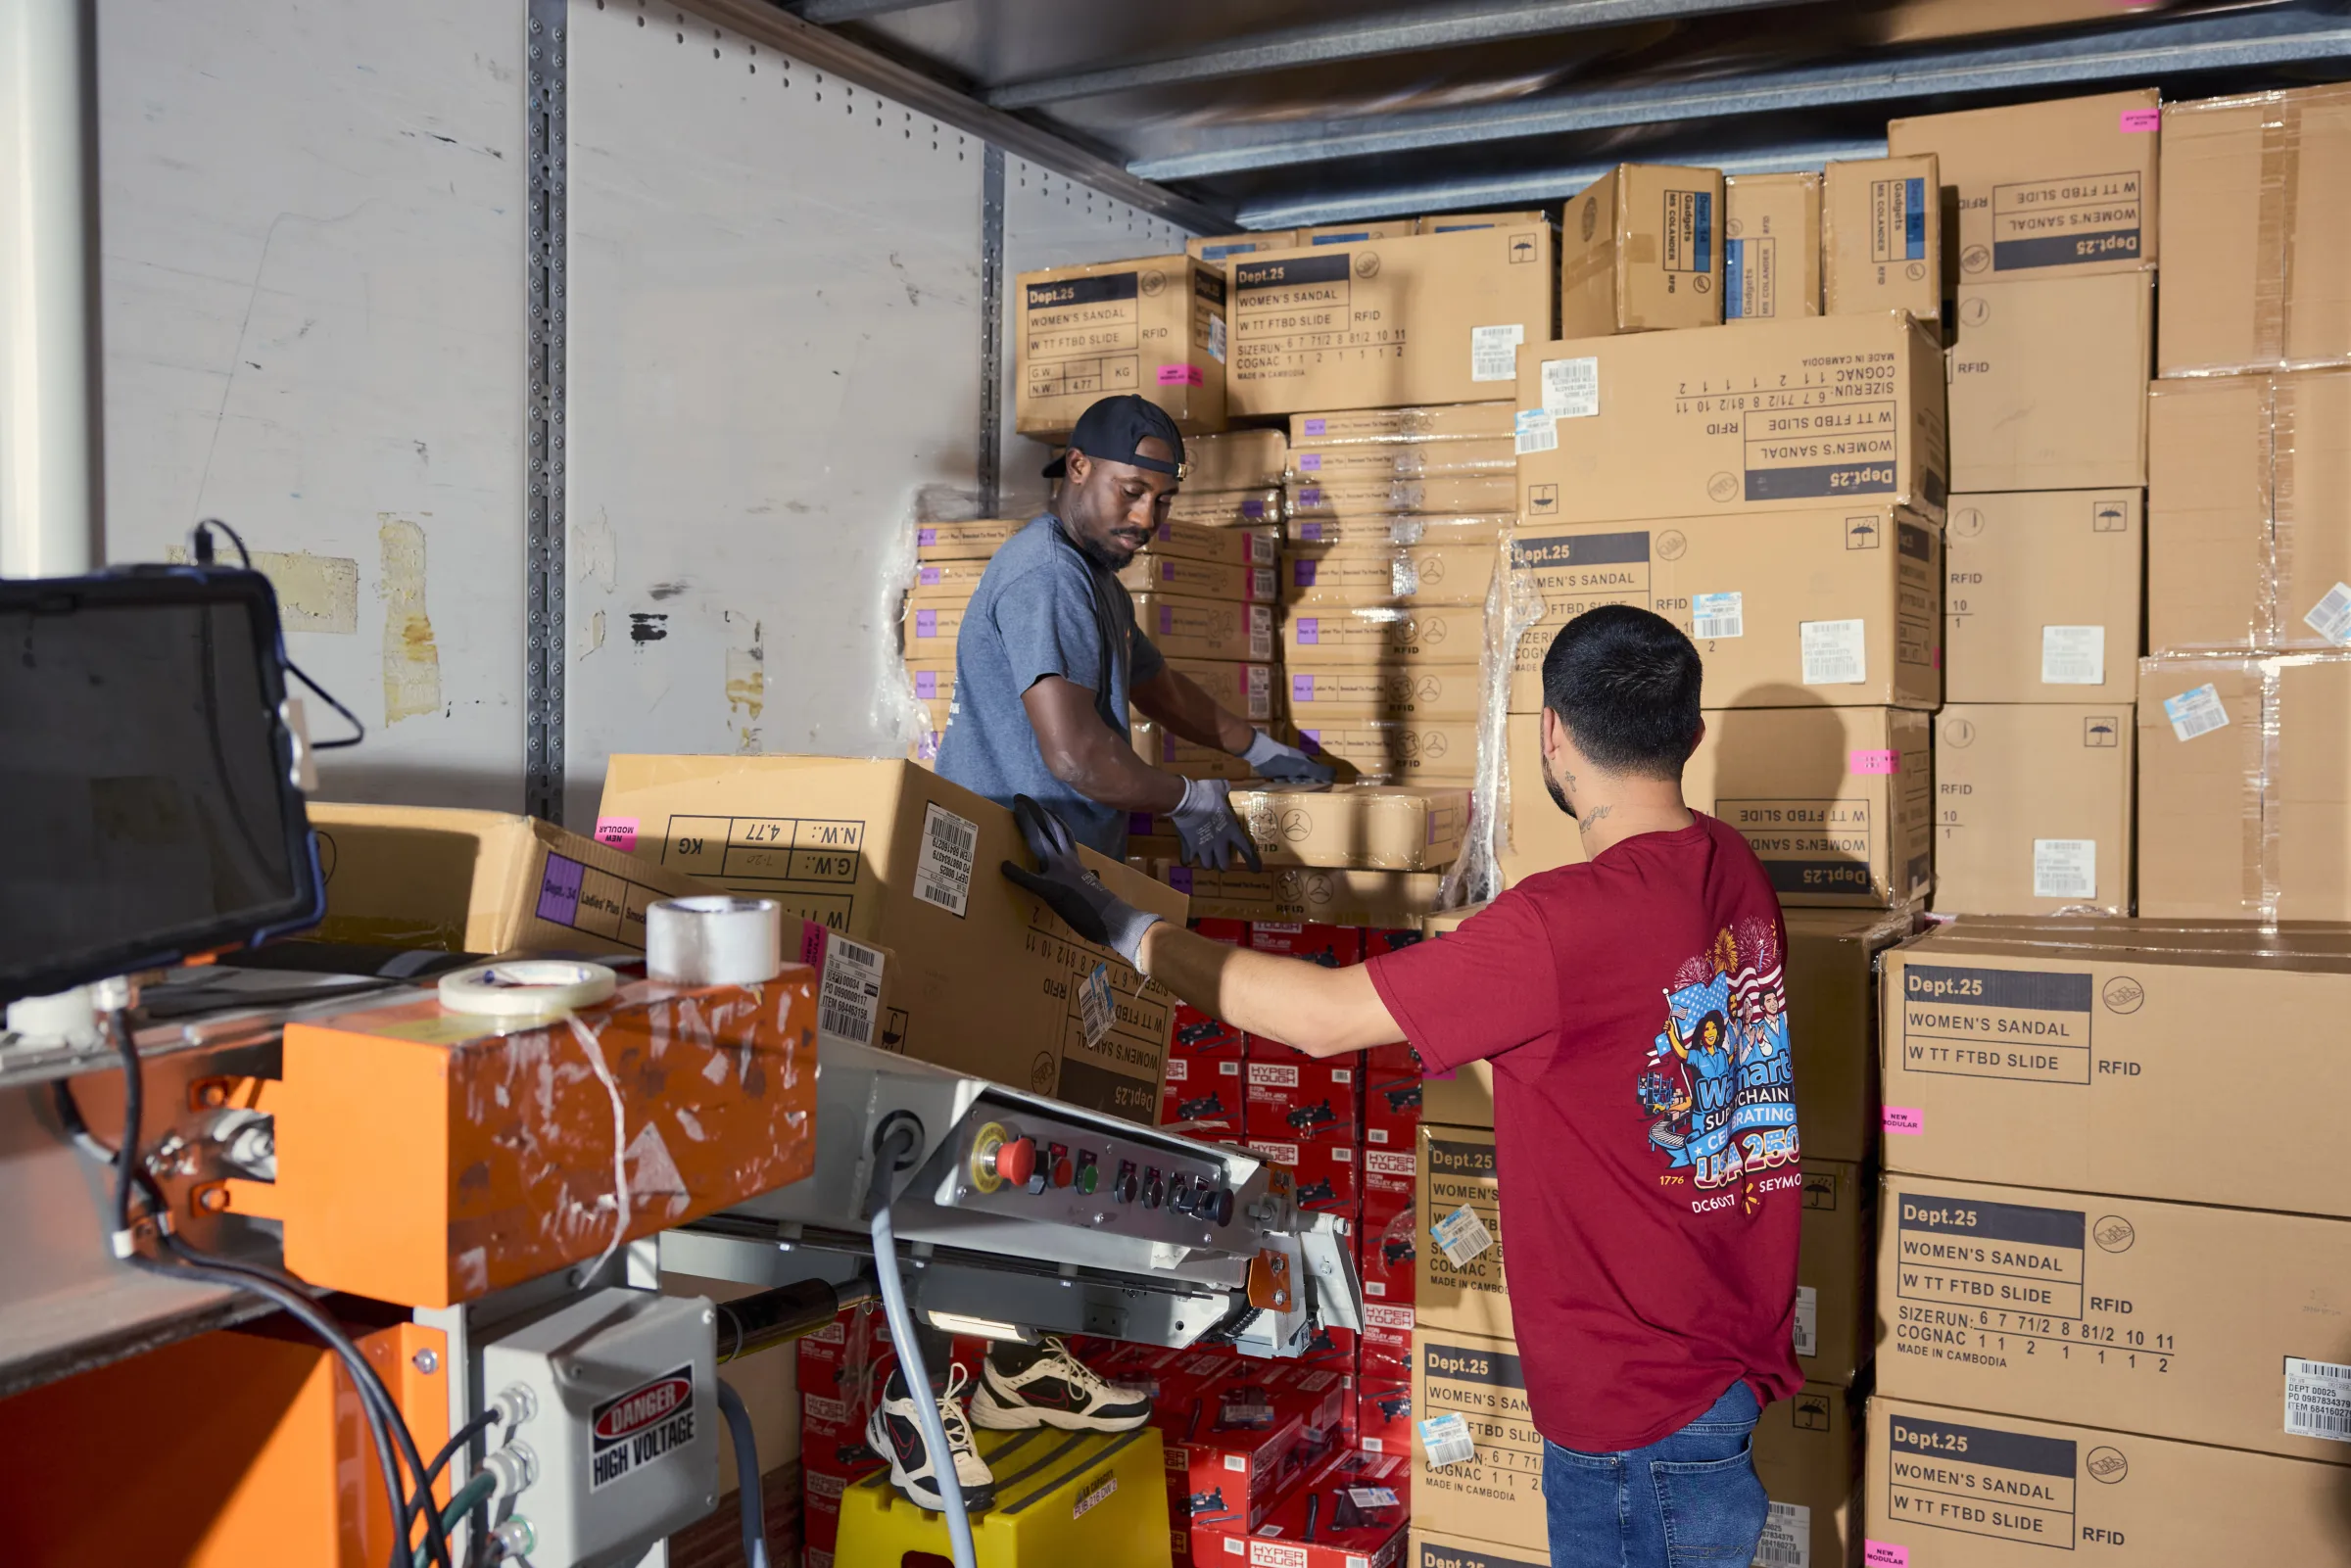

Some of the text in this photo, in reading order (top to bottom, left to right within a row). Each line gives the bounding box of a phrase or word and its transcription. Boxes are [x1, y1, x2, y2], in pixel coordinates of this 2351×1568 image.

[2017, 181, 2136, 204] W TT FTBD SLIDE
[1894, 183, 1904, 230] Gadgets
[1683, 195, 1694, 242] Gadgets
[2009, 208, 2136, 232] WOMEN'S SANDAL
[1668, 212, 1677, 261] COLANDER
[2076, 236, 2137, 256] Dept.25
[1238, 267, 1285, 284] Dept.25
[1030, 287, 1075, 305] Dept.25
[1239, 290, 1338, 308] WOMEN'S SANDAL
[1744, 268, 1754, 315] Gadgets
[1032, 309, 1126, 327] WOMEN'S SANDAL
[1269, 313, 1332, 329] FTBD SLIDE
[1354, 309, 1381, 322] RFID
[1089, 332, 1120, 346] SLIDE
[1143, 327, 1168, 340] RFID
[1237, 356, 1280, 370] COGNAC
[1801, 353, 1895, 367] MADE IN CAMBODIA
[1957, 361, 1990, 374] RFID
[1115, 367, 1130, 378] KG
[1836, 364, 1895, 382] COGNAC
[1706, 421, 1739, 436] RFID
[1768, 410, 1893, 432] W TT FTBD SLIDE
[1760, 439, 1893, 460] WOMEN'S SANDAL
[1830, 468, 1894, 488] Dept.25
[1581, 572, 1635, 586] SANDAL
[1950, 573, 1983, 585] RFID
[1551, 602, 1585, 615] FTBD
[1655, 597, 1688, 610] RFID
[1952, 599, 1967, 612] 10
[1389, 704, 1415, 713] RFID
[1941, 784, 1973, 795] RFID
[1740, 809, 1865, 823] W TT FTBD SLIDE
[1943, 810, 1958, 822] 10
[599, 826, 634, 834] MODULAR
[604, 834, 623, 843] NEW
[745, 824, 781, 841] 4.77
[678, 837, 703, 855] KG
[1796, 838, 1866, 852] WOMEN'S
[960, 849, 973, 863] ITEM
[1802, 868, 1867, 885] Dept.25
[1275, 904, 1305, 914] RFID
[1043, 977, 1068, 1000] RFID
[1908, 974, 1984, 997] Dept.25
[1115, 1004, 1153, 1029] TT FTBD
[1909, 1013, 2070, 1037] WOMEN'S SANDAL
[1116, 1043, 1158, 1070] WOMEN'S
[1908, 1045, 2059, 1070] W TT FTBD SLIDE
[1251, 1066, 1296, 1076] HYPER
[2098, 1060, 2142, 1077] RFID
[1251, 1074, 1296, 1084] TOUGH
[1115, 1085, 1154, 1112] Dept.25
[1738, 1087, 1790, 1106] CHAIN
[1368, 1153, 1415, 1164] HYPER
[1432, 1150, 1493, 1169] Dept.25
[1694, 1124, 1800, 1189] USA 250
[1369, 1162, 1415, 1173] TOUGH
[1659, 1174, 1685, 1186] 1776
[1433, 1182, 1499, 1202] WOMEN'S
[1692, 1173, 1801, 1213] DC6017 SEYMO
[1902, 1204, 1978, 1227] Dept.25
[1903, 1240, 2063, 1272] WOMEN'S SANDAL
[1430, 1258, 1486, 1277] COGNAC
[1430, 1275, 1468, 1289] MADE IN
[1902, 1273, 2052, 1305] W TT FTBD SLIDE
[1366, 1306, 1411, 1317] HYPER
[2089, 1296, 2134, 1314] RFID
[1366, 1314, 1412, 1326] TOUGH
[1898, 1305, 2175, 1350] SIZERUN: 6 7 71/2 8 81/2 10 11
[1896, 1323, 1967, 1347] COGNAC
[1427, 1353, 1489, 1375] Dept.25
[1896, 1343, 2007, 1368] MADE IN CAMBODIA
[1428, 1386, 1496, 1407] WOMEN'S
[2288, 1383, 2336, 1398] DEPT 00025
[610, 1382, 676, 1435] DANGER
[2288, 1393, 2351, 1408] PO 0987834379
[2288, 1402, 2308, 1411] ITEM
[1509, 1428, 1541, 1444] SLID
[1894, 1425, 1969, 1452] Dept.25
[594, 1412, 695, 1487] HIGH VOLTAGE
[1492, 1450, 1500, 1463] 6
[1508, 1452, 1515, 1465] 7
[1424, 1459, 1482, 1481] COGNAC
[1425, 1477, 1515, 1502] MADE IN CAMBODIA
[1894, 1462, 2055, 1501] WOMEN'S SANDAL
[1894, 1495, 2043, 1533] W TT FTBD SLIDE
[2082, 1527, 2126, 1546] RFID
[1253, 1544, 1305, 1558] HYPER
[1866, 1553, 1904, 1566] MODULAR
[1876, 1548, 1894, 1557] NEW
[1253, 1554, 1305, 1568] TOUGH
